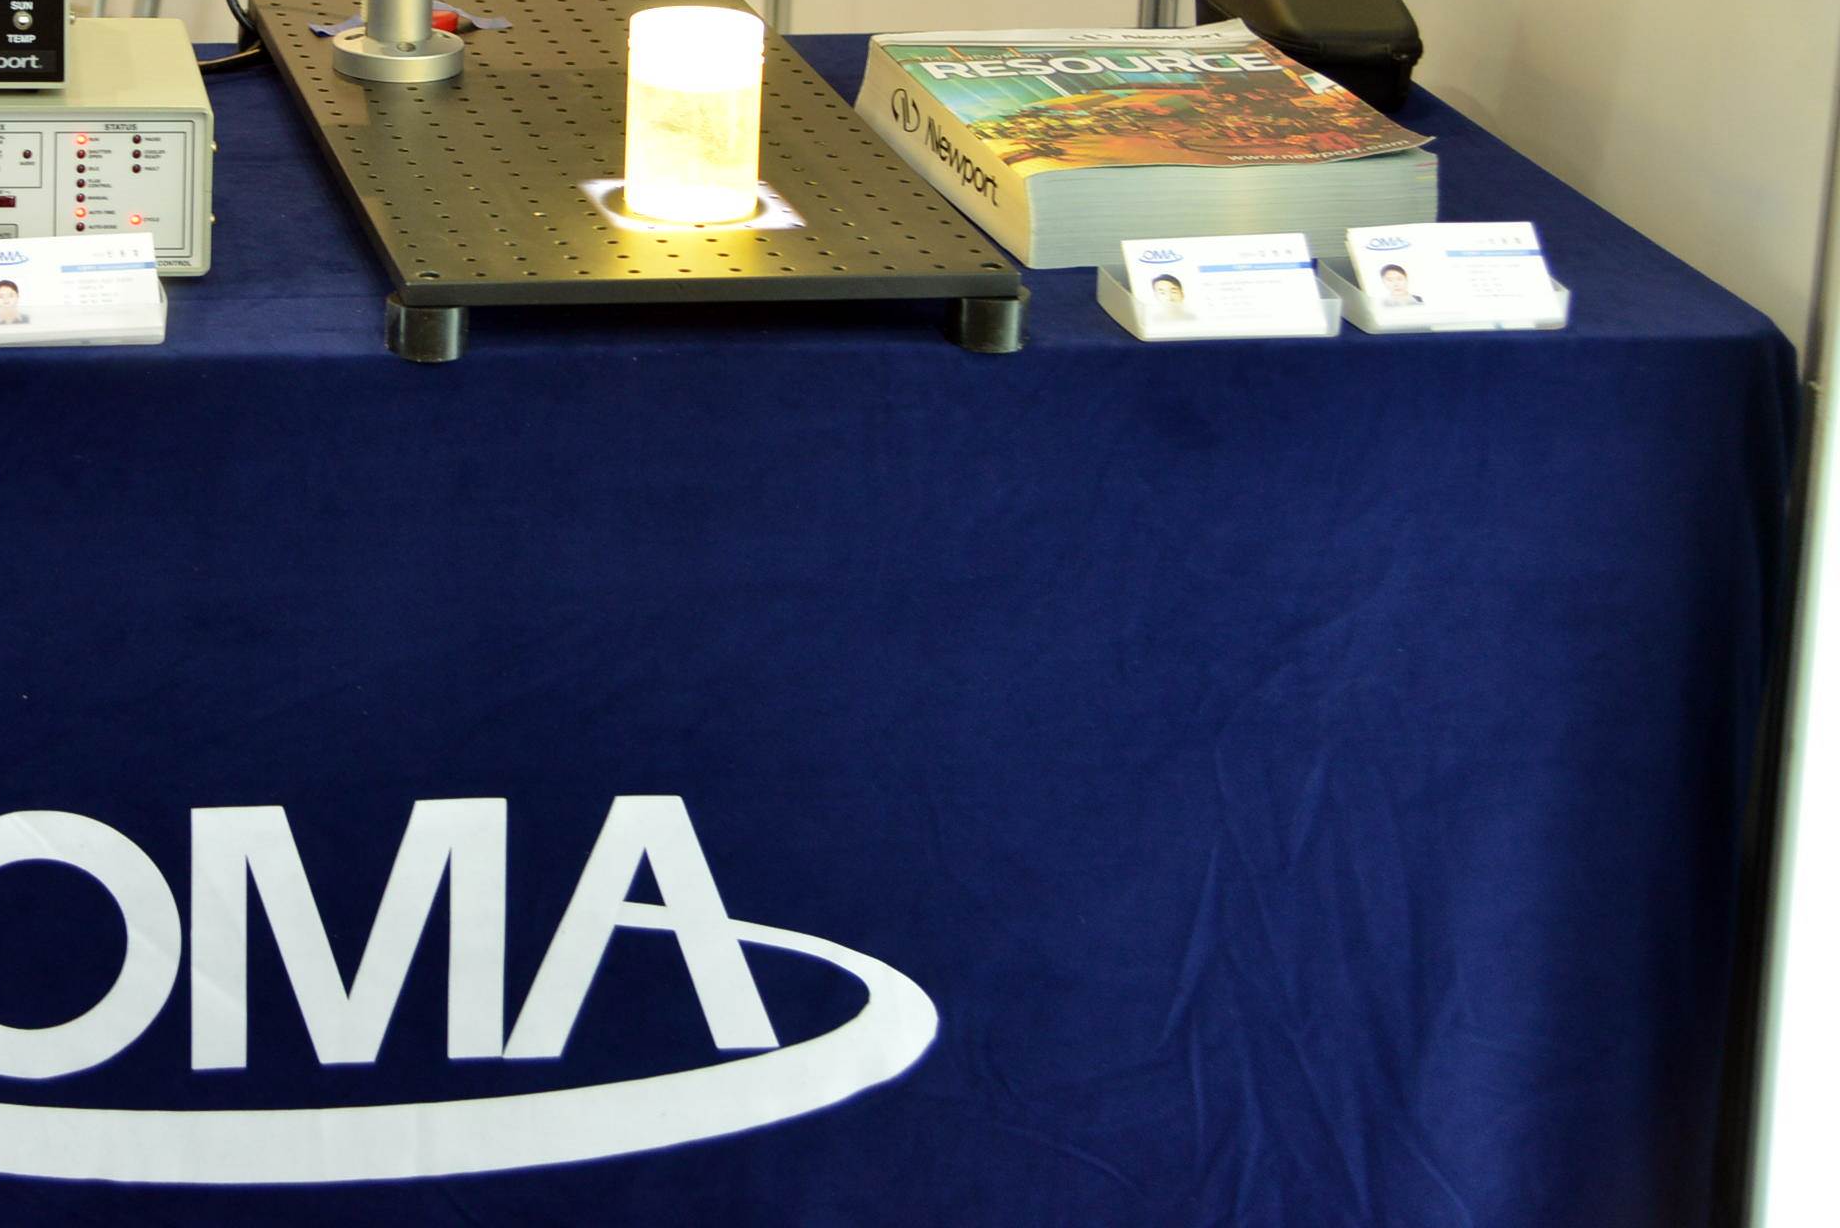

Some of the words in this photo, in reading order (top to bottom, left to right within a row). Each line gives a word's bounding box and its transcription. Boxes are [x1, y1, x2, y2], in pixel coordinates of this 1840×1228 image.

[10, 1, 33, 11] SUN
[7, 34, 36, 44] TEMP
[1121, 30, 1223, 43] Newport
[919, 51, 1283, 80] RESOURCE
[1228, 139, 1409, 162] www.newport.com
[926, 115, 1000, 207] Newport
[1368, 236, 1408, 250] OMA
[1142, 249, 1179, 263] OMA
